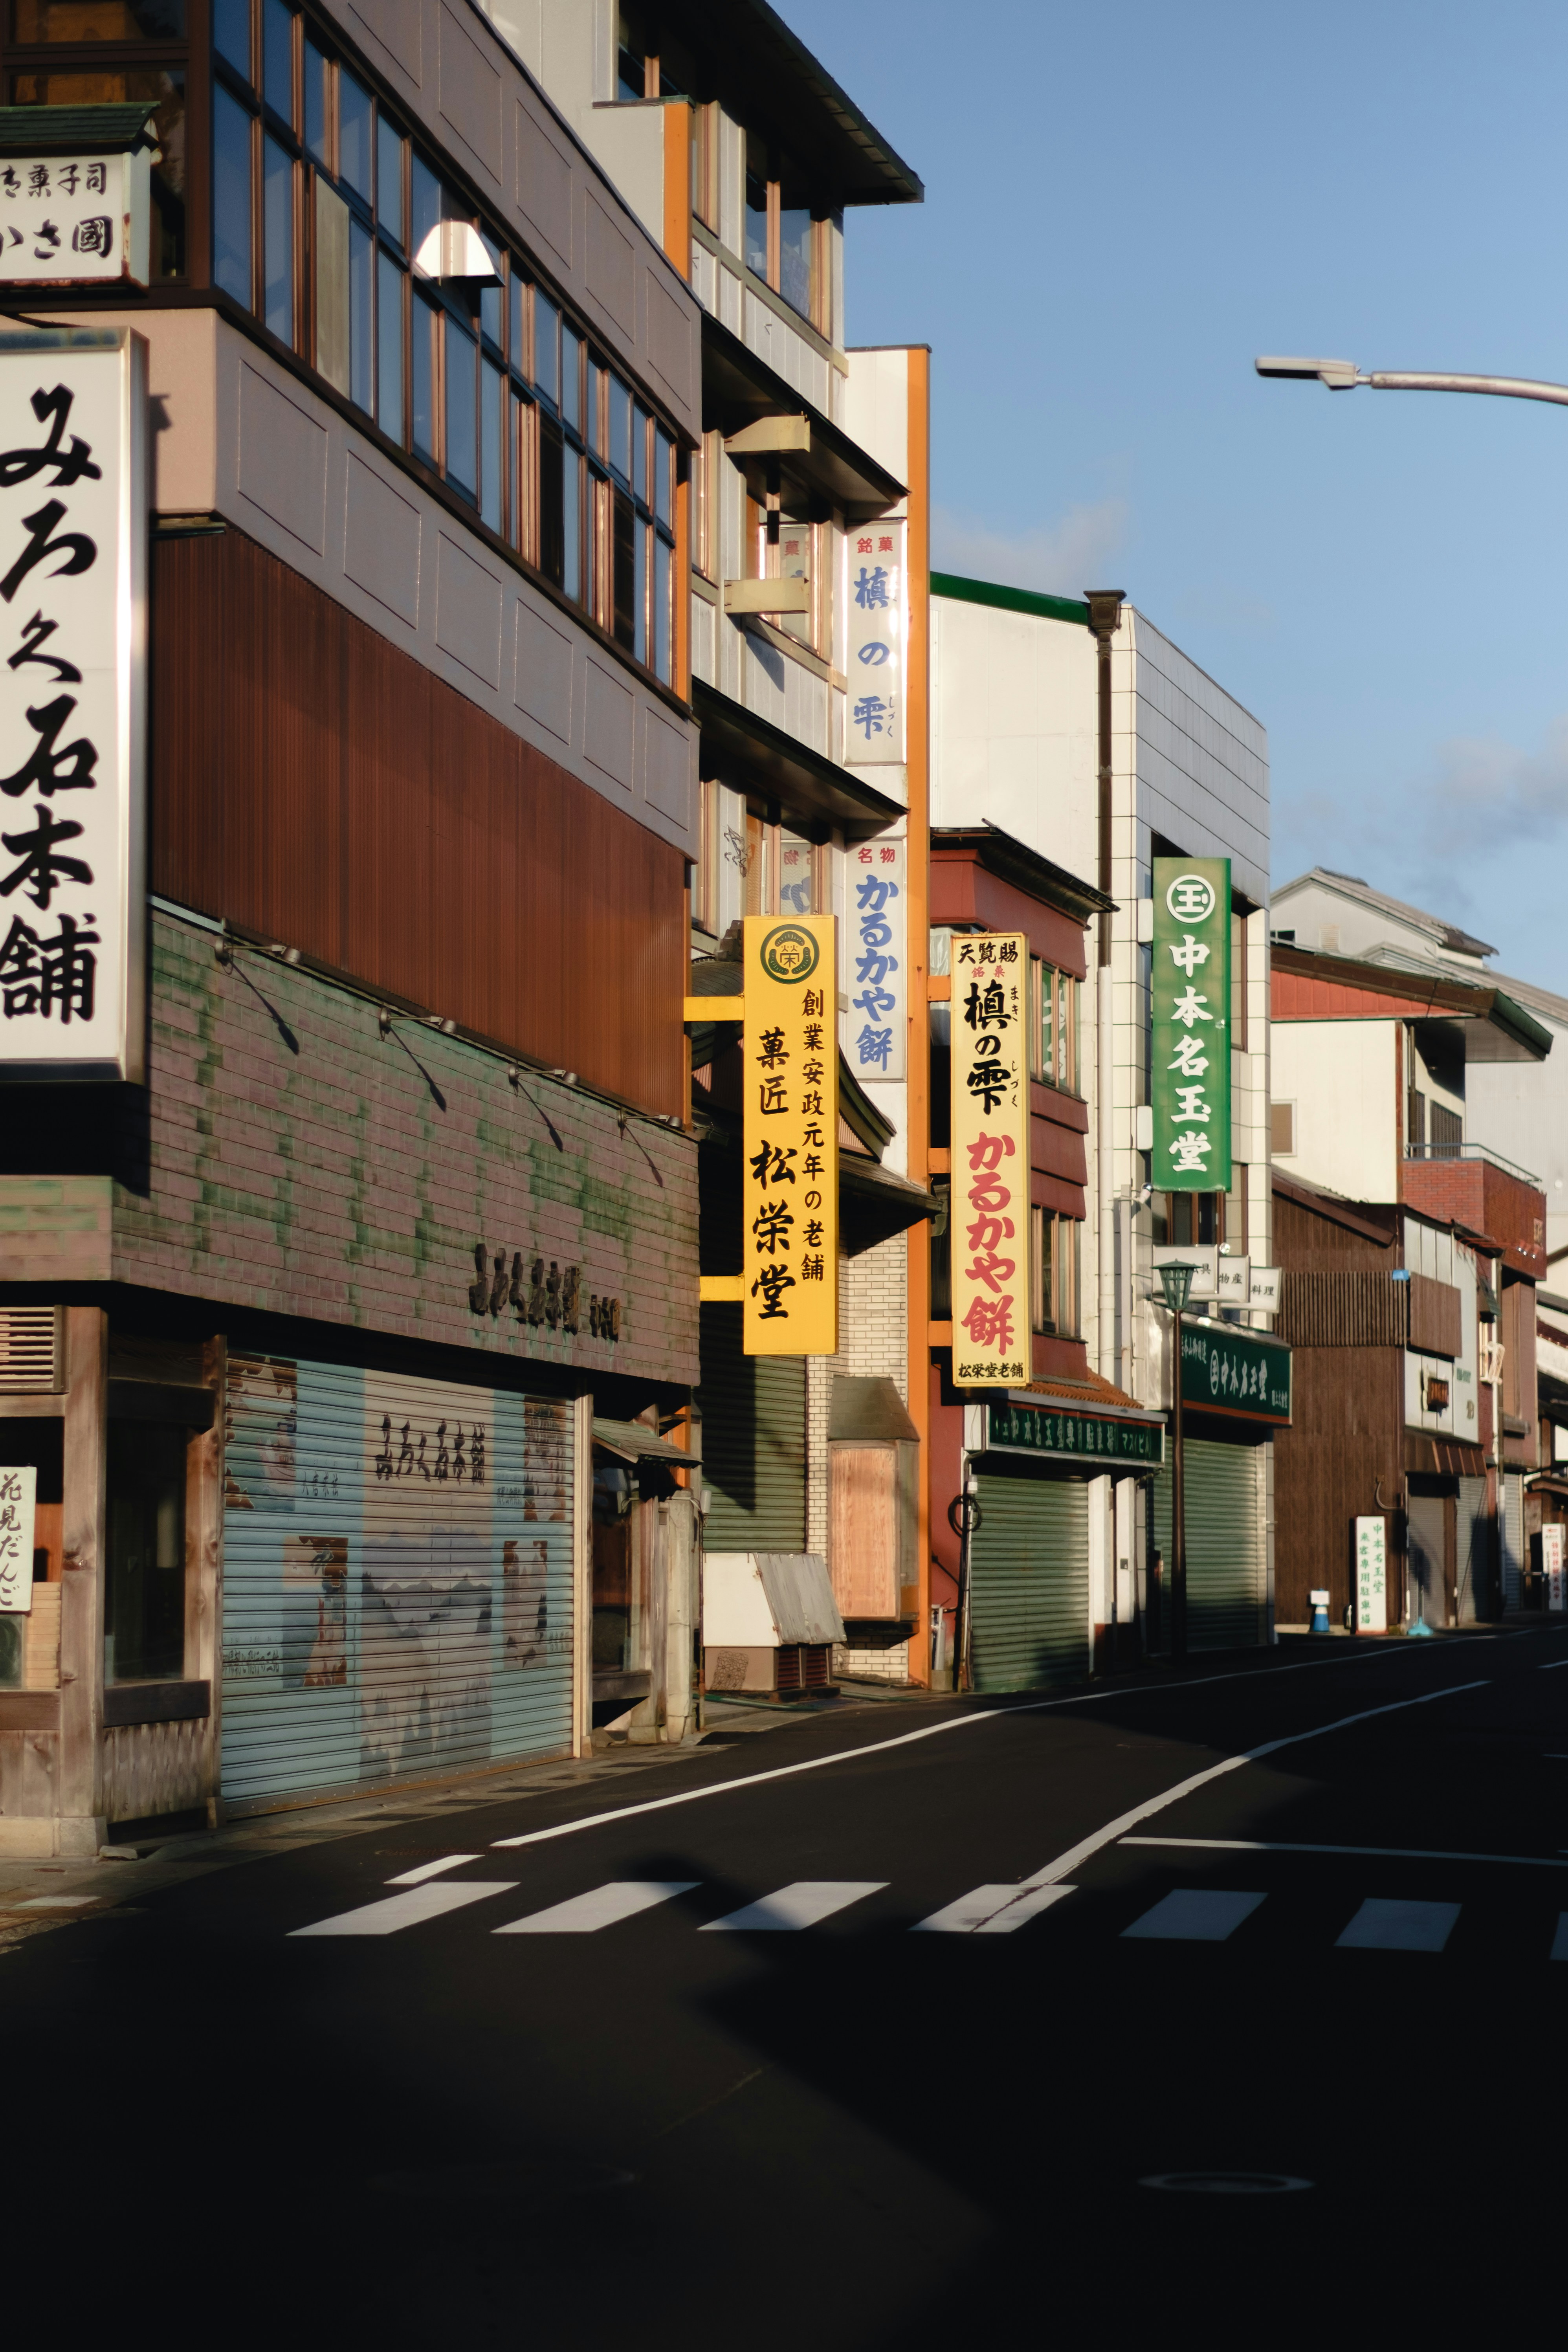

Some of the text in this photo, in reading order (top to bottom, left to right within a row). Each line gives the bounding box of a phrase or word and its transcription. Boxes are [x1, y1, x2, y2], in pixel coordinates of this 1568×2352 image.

[857, 536, 893, 554] 銘菓
[0, 382, 102, 1025] みろく石本舗
[858, 848, 895, 864] 名物
[853, 875, 899, 1071] かるかや餅
[1166, 934, 1214, 1172] 中本名玉堂
[749, 1026, 798, 1319] 菓匠 松栄堂
[801, 989, 825, 1282] 創業安政元年の老舗
[961, 1132, 1015, 1355] かるかや餅
[1221, 1352, 1267, 1401] 中本名玉堂
[0, 1473, 23, 1605] 花見だんご
[1373, 1523, 1384, 1593] 中本名玉堂
